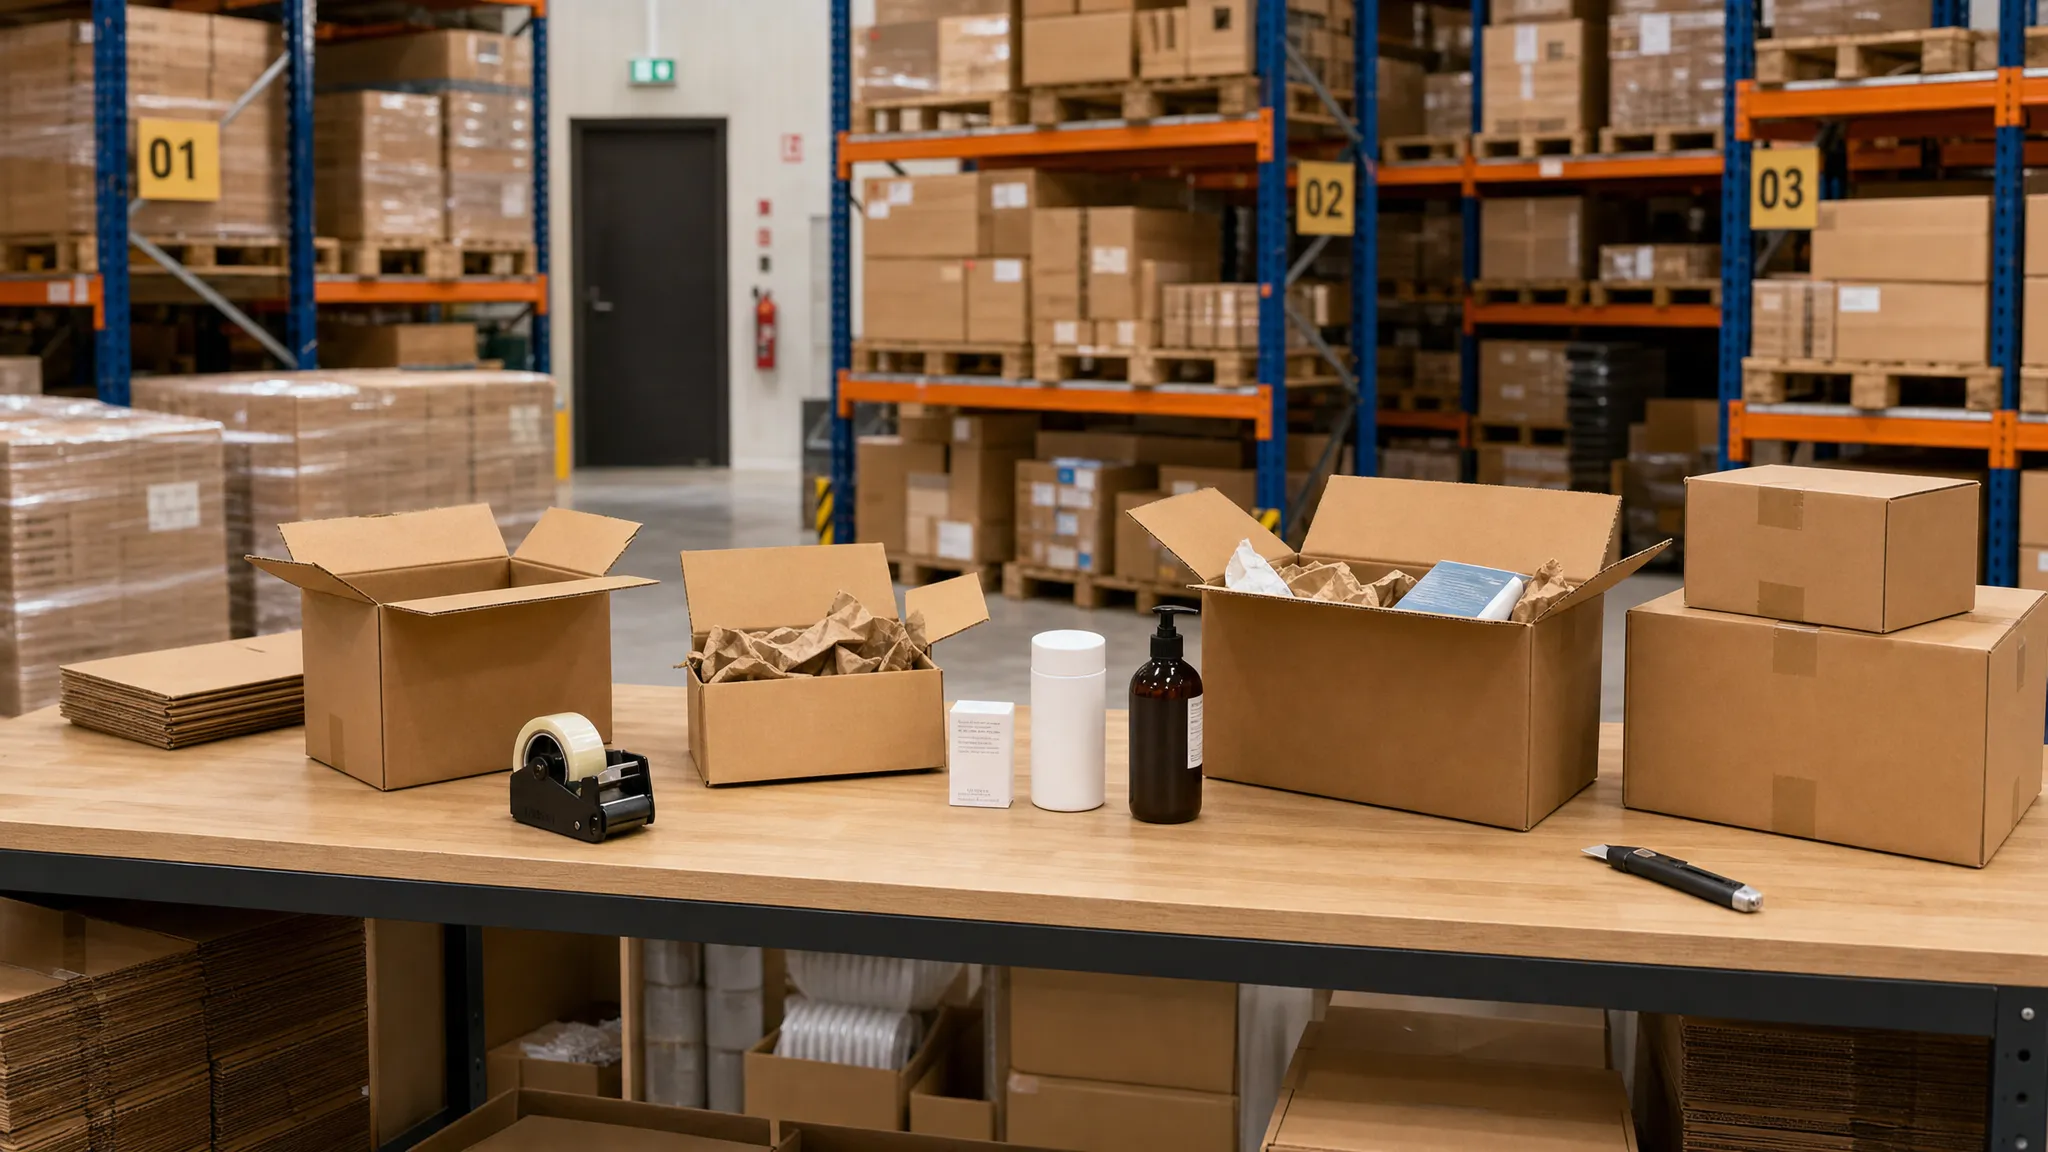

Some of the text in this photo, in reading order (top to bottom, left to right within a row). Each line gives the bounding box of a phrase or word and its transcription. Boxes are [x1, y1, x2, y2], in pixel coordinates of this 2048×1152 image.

[149, 137, 195, 180] 01
[1305, 178, 1344, 218] 02
[1759, 167, 1803, 210] 03
